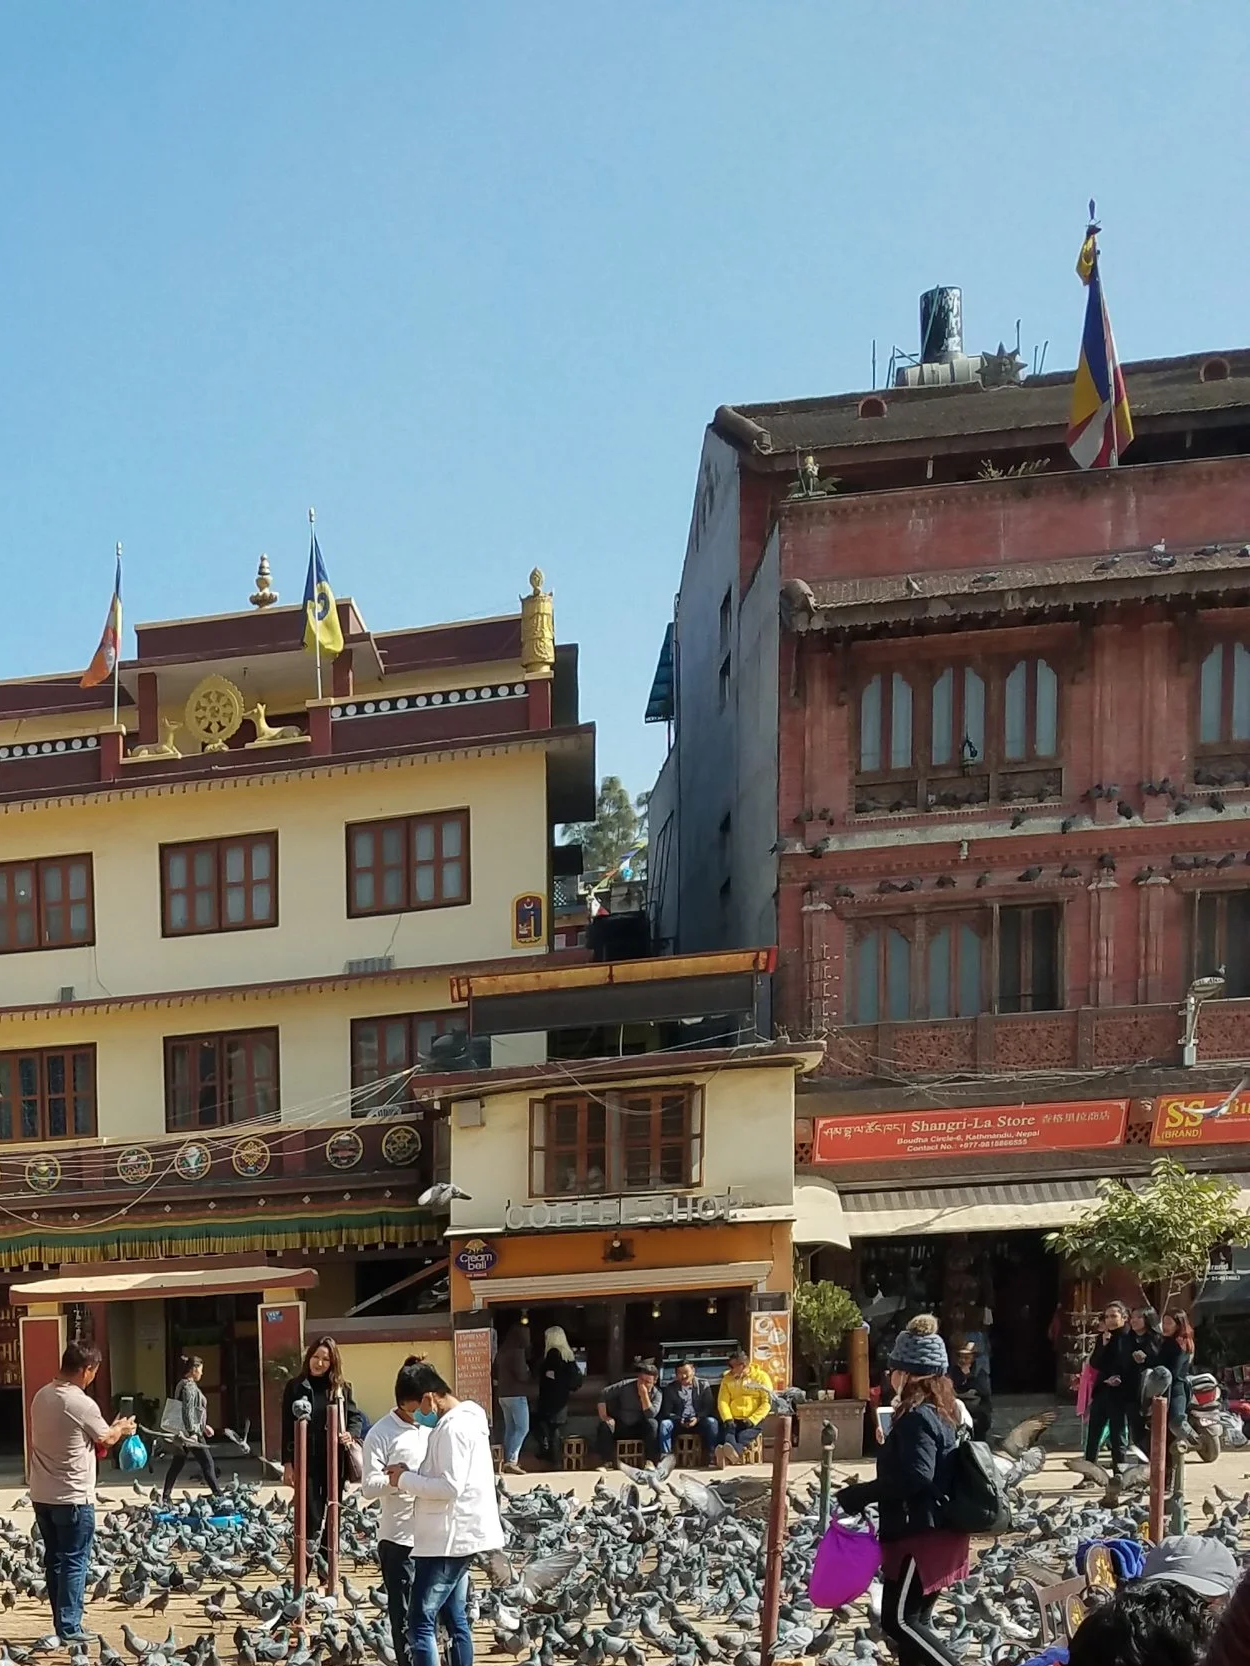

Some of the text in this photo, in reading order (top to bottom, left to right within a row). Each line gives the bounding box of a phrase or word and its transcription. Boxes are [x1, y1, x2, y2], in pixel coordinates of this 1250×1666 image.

[911, 1116, 1036, 1133] Shangri-La Store
[966, 1131, 1015, 1141] Kathmandu,
[1016, 1130, 1040, 1138] Nepal
[1161, 1128, 1202, 1140] (BRAND)
[907, 1143, 938, 1152] Contact
[506, 1192, 744, 1230] COFFEE SHOP
